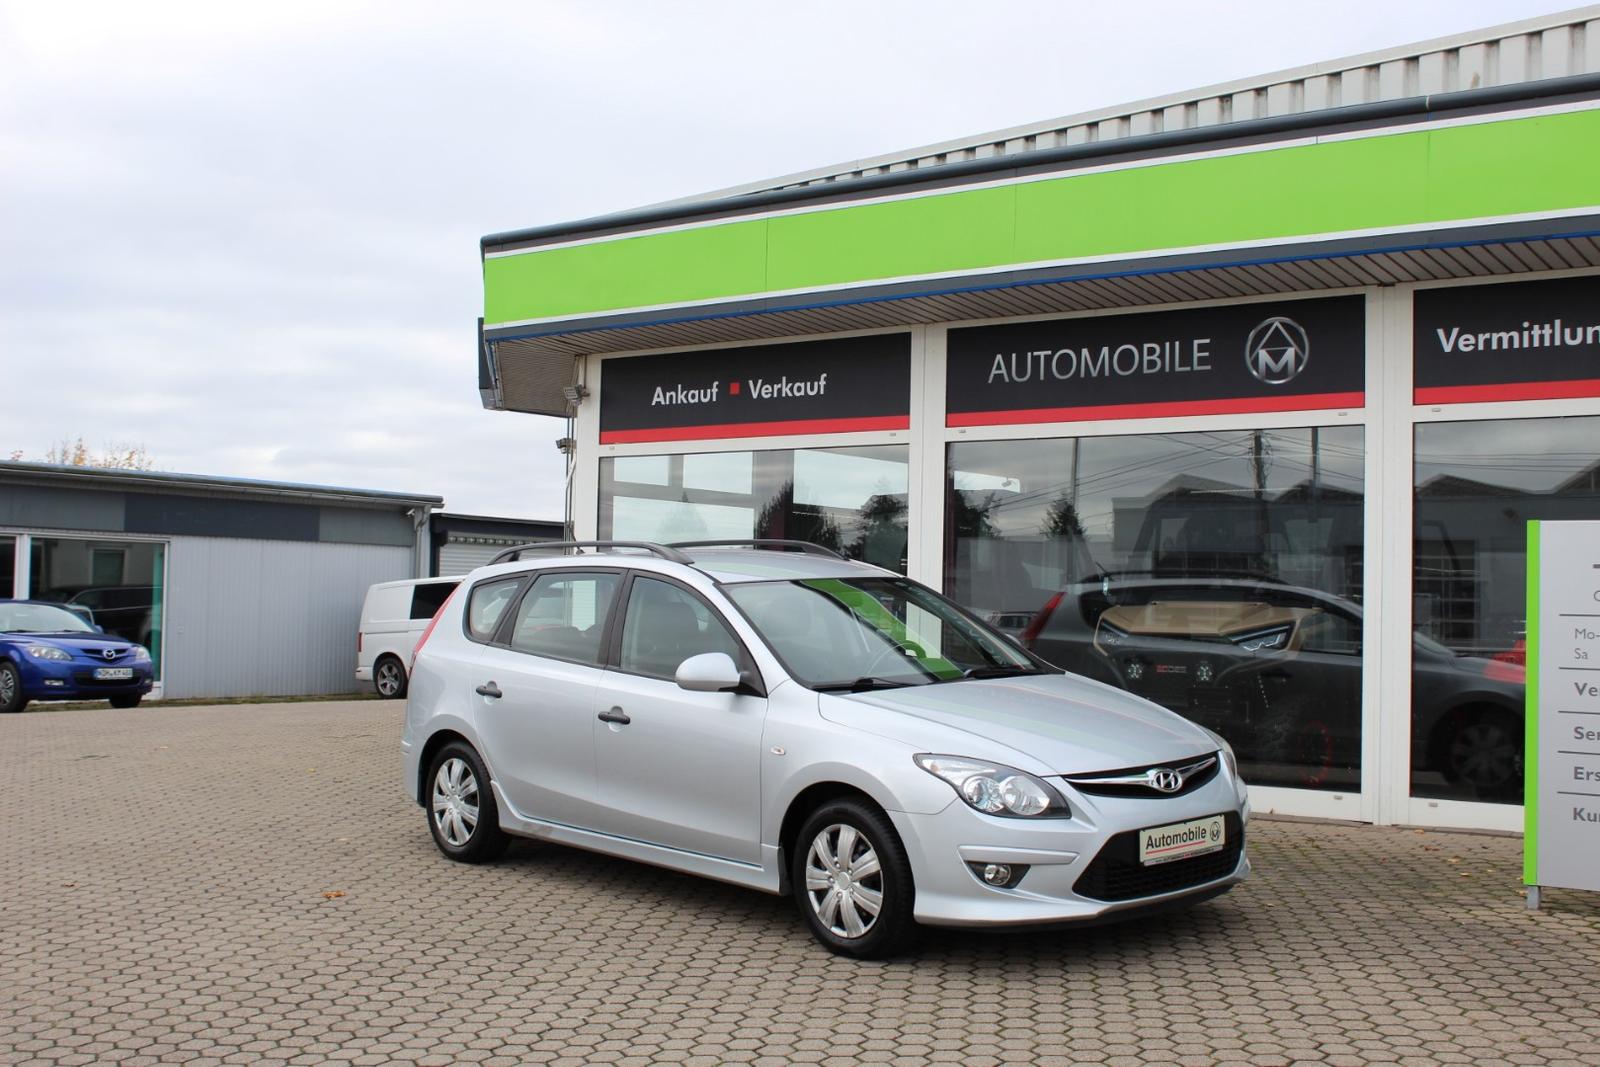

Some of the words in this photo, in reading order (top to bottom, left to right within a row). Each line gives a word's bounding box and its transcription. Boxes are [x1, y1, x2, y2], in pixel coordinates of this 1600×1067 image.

[988, 338, 1212, 385] AUTOMOBILE
[651, 381, 719, 406] Ankauf
[748, 373, 827, 399] Verkauf
[1574, 647, 1588, 660] Sa
[1574, 682, 1600, 697] Ve
[1572, 807, 1600, 823] Ku
[1145, 826, 1207, 850] Automobile
